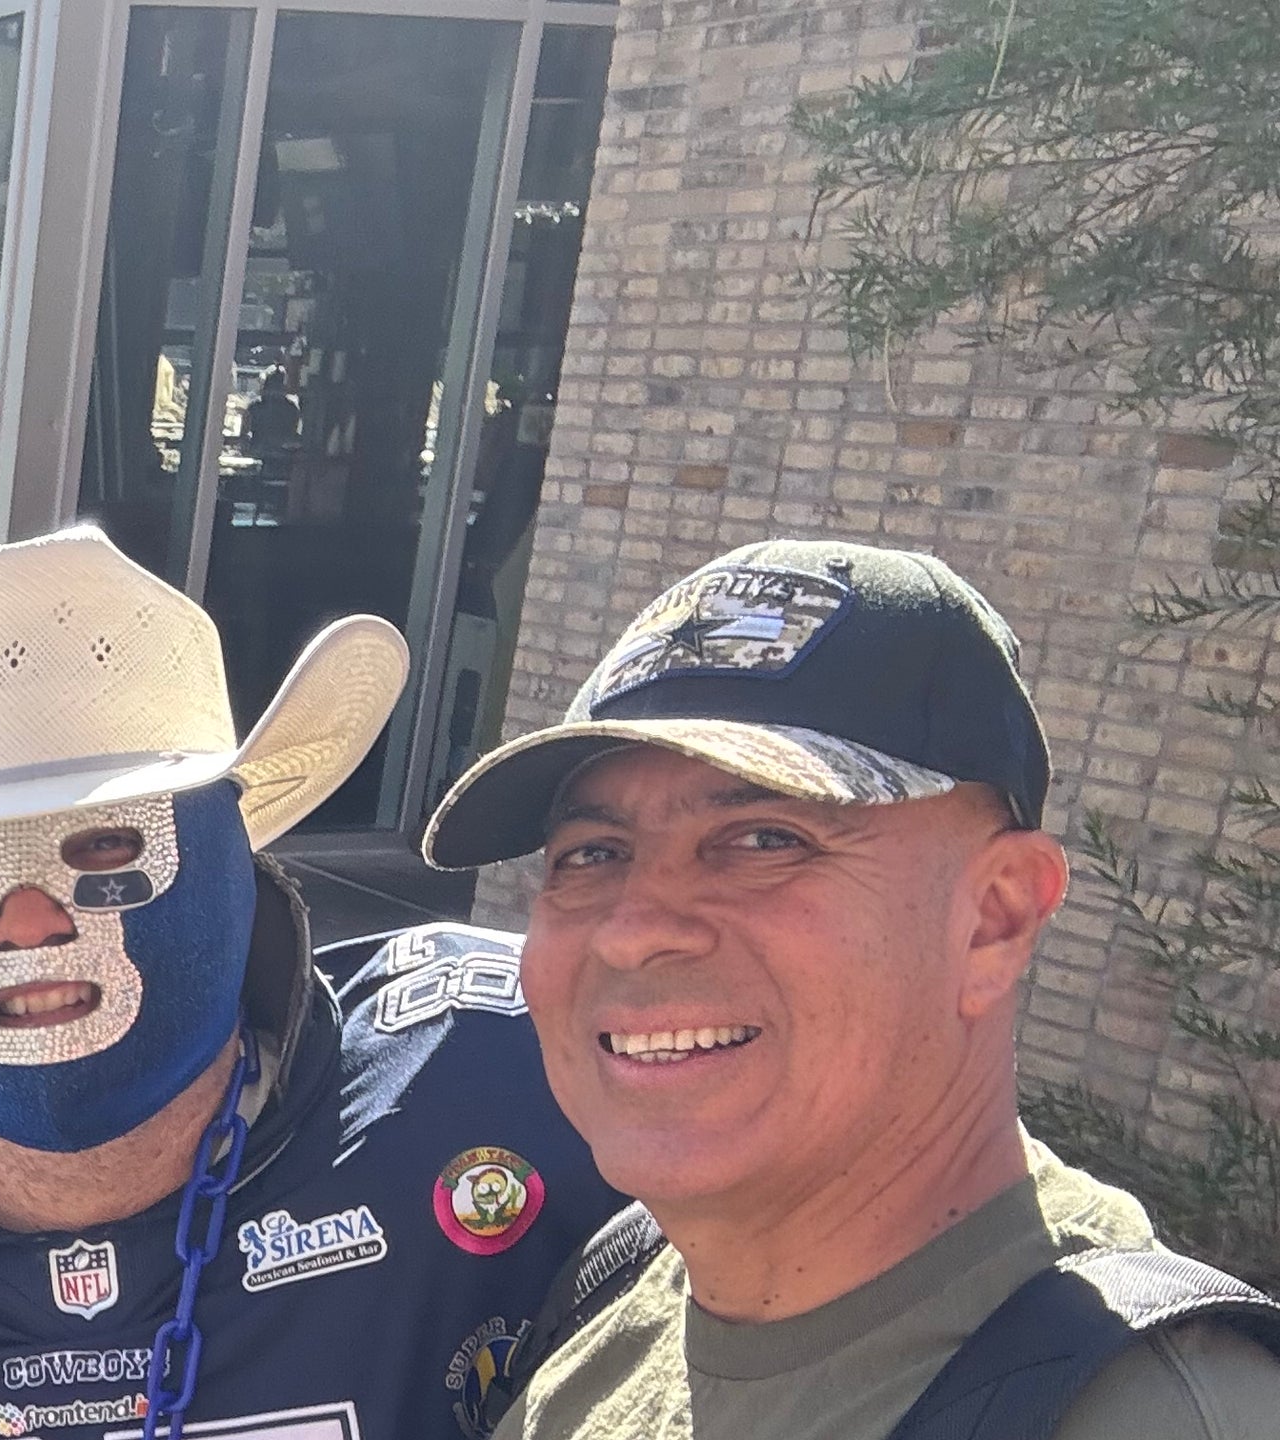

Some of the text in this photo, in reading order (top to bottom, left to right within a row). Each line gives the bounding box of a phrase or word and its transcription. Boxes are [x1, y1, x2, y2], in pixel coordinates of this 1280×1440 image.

[270, 1210, 380, 1262] SIRENA
[63, 1271, 109, 1304] NFL
[250, 1264, 297, 1285] Mexican
[3, 1348, 170, 1390] COWBOY
